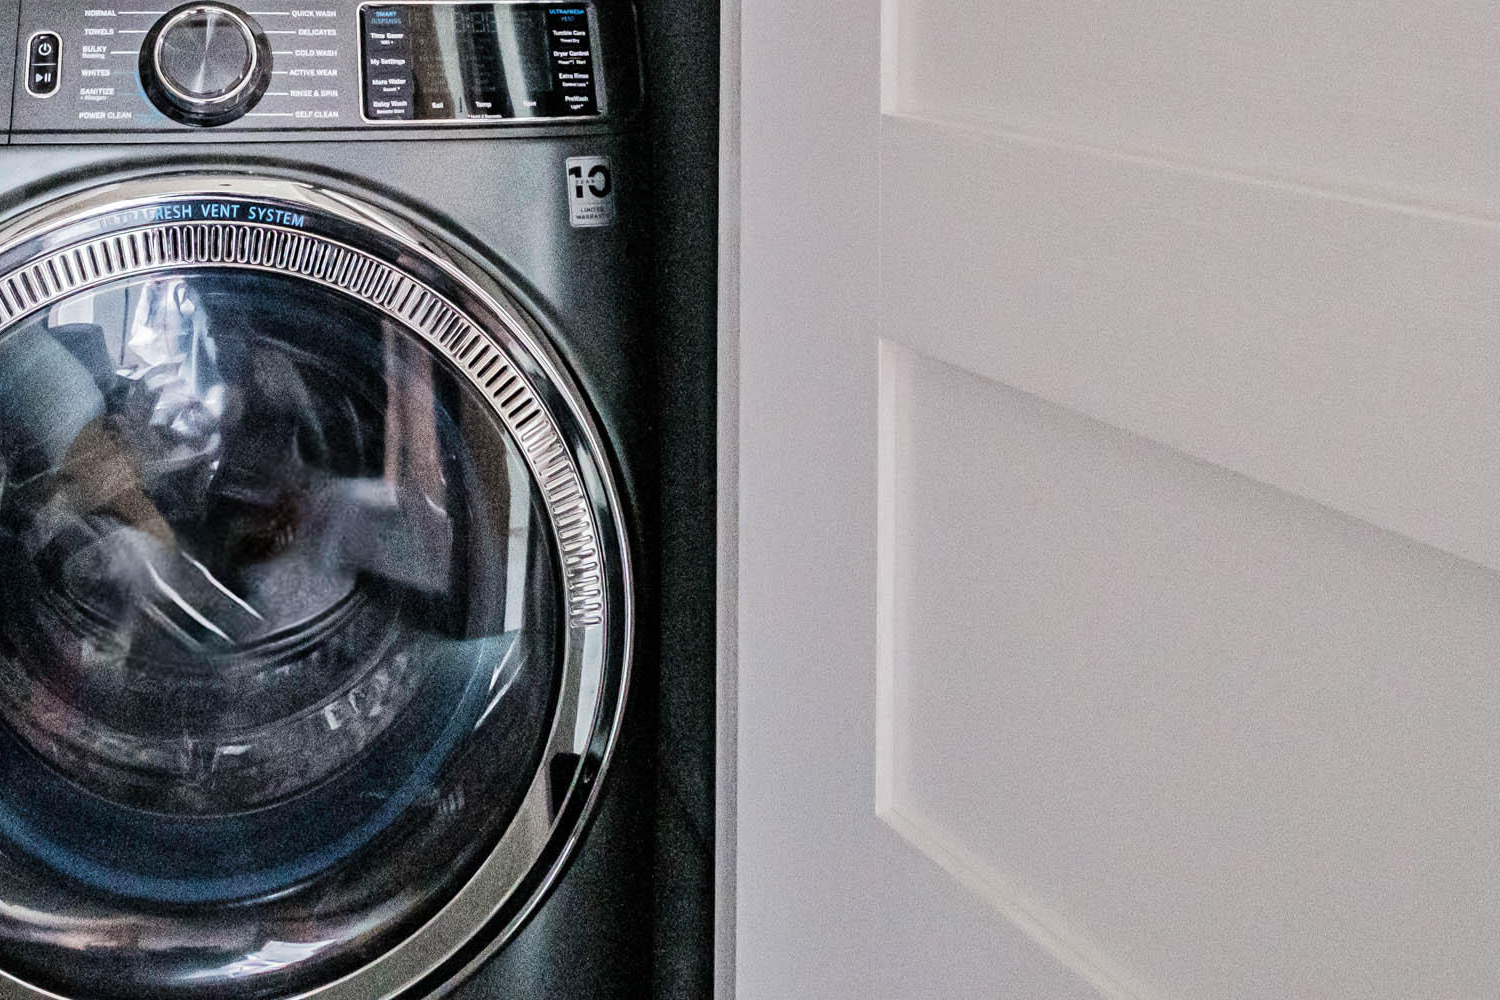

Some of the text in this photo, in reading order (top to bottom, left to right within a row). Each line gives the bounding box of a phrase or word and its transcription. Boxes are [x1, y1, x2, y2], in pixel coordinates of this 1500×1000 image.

[84, 9, 117, 17] NORMAL
[84, 28, 114, 36] TOWELS
[298, 28, 337, 36] DELICATES
[82, 45, 107, 53] BULKY
[294, 49, 338, 57] COLD WASH
[290, 89, 339, 97] RINSE & SPIN
[78, 111, 132, 119] POWER CLEAN
[294, 110, 339, 118] SELF CLEAN
[569, 165, 612, 198] 10
[201, 204, 240, 219] VENT
[249, 206, 305, 228] SYSTEM
